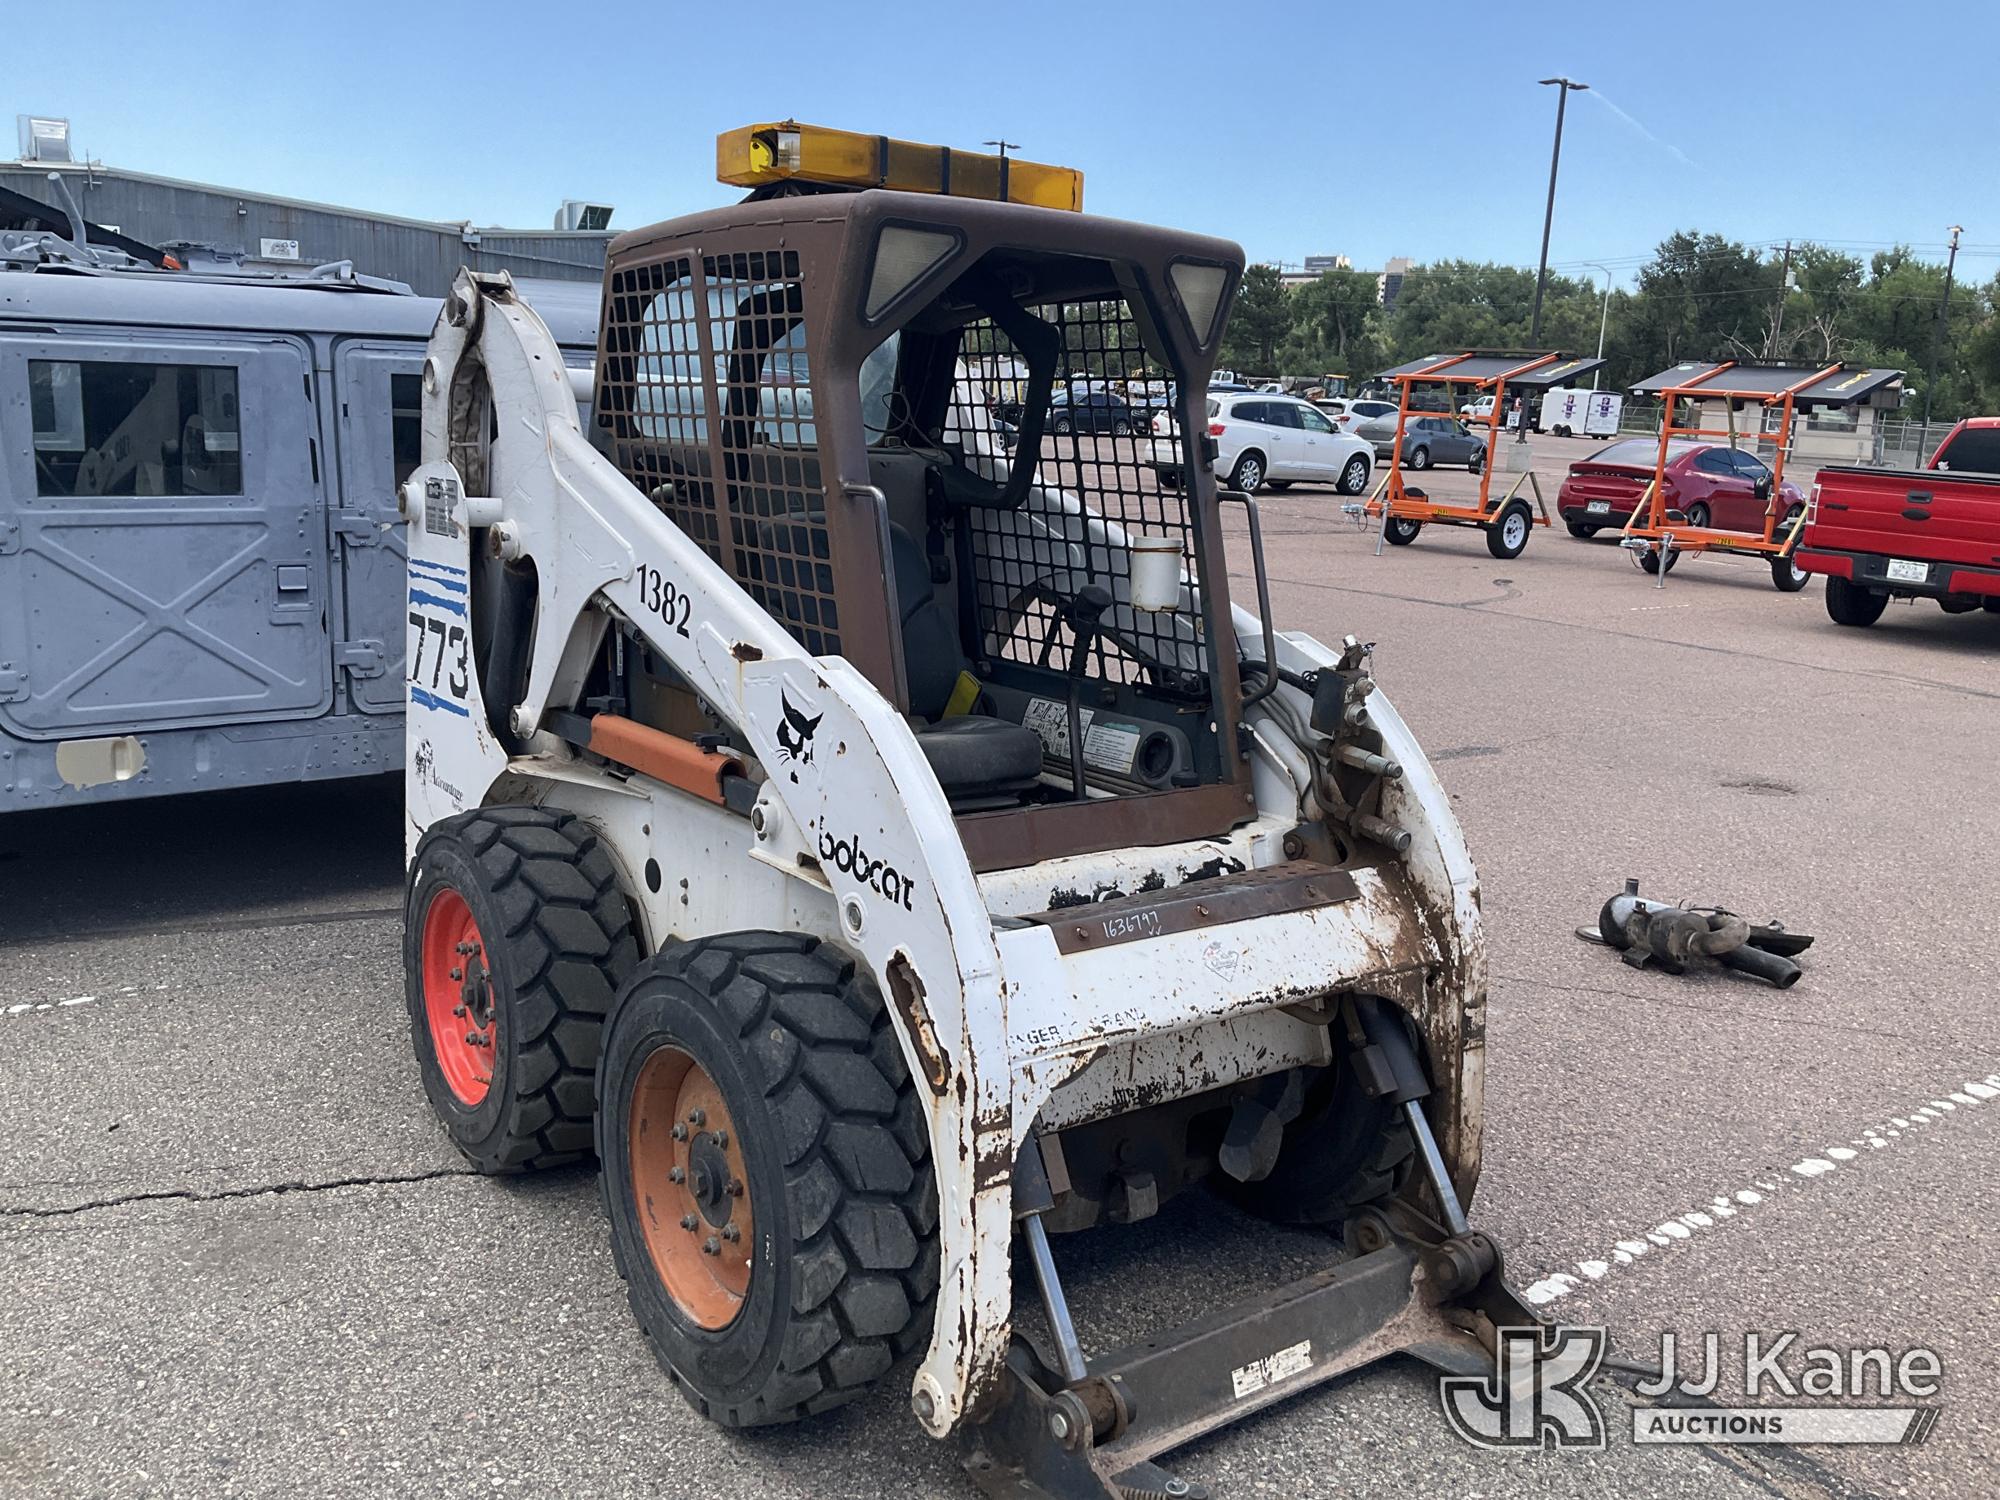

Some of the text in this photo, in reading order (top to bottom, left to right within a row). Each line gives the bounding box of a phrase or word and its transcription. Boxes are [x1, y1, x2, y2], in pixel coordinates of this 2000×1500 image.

[636, 563, 692, 639] 1382
[407, 611, 469, 700] 773
[818, 815, 915, 913] bobcat
[1101, 910, 1159, 939] 1636797
